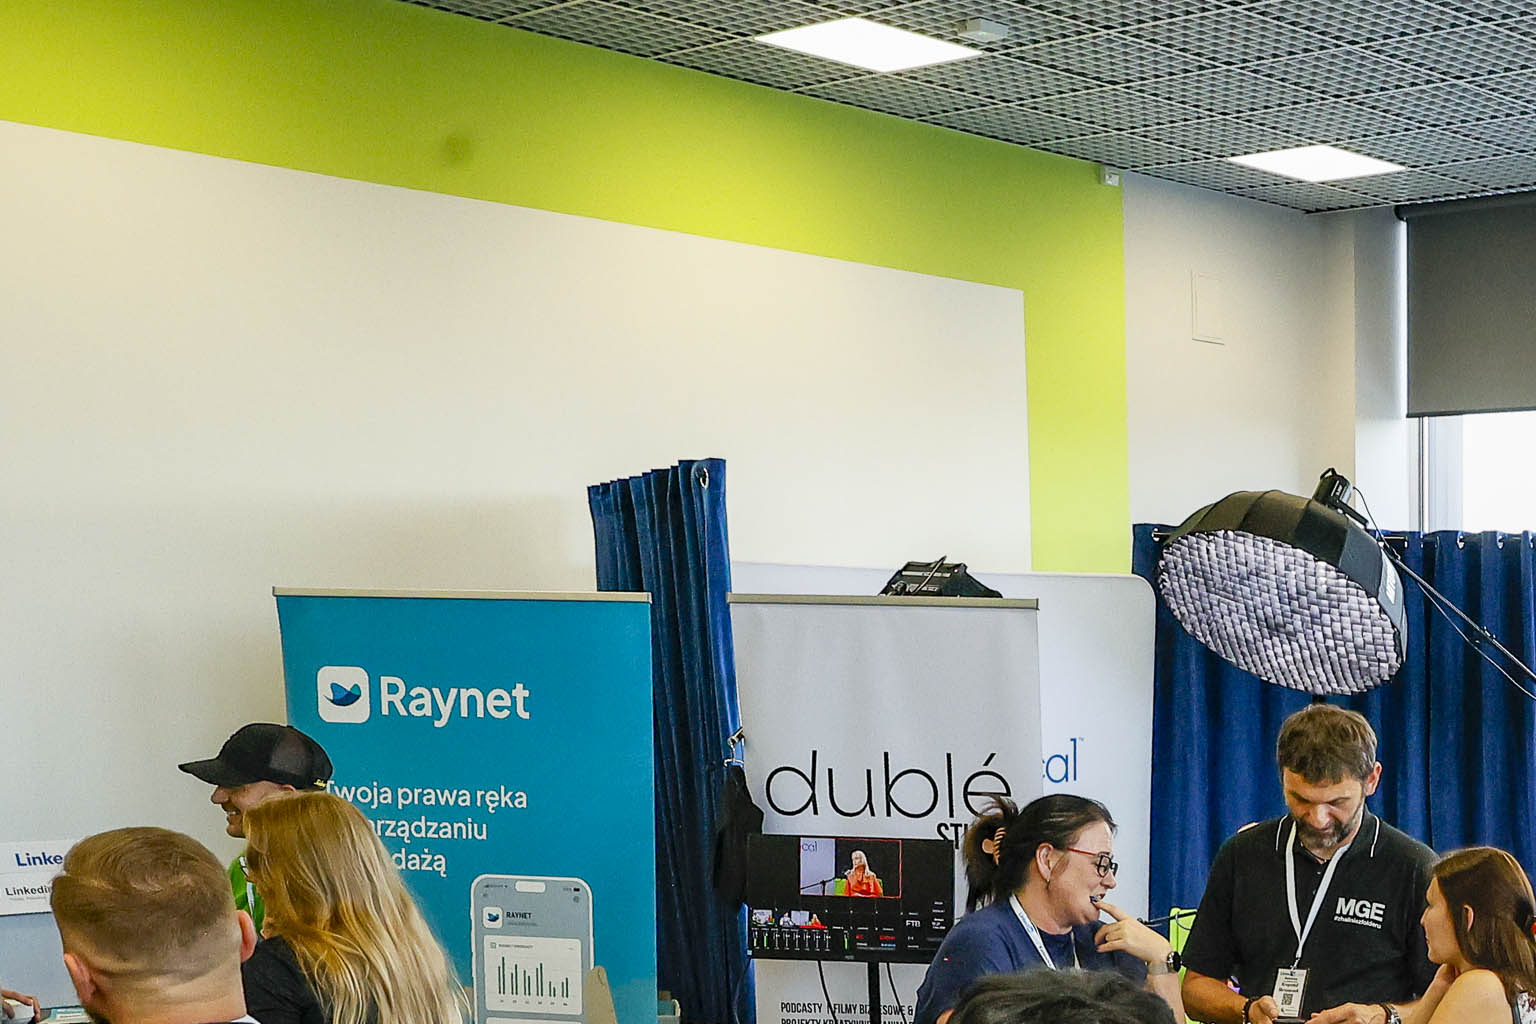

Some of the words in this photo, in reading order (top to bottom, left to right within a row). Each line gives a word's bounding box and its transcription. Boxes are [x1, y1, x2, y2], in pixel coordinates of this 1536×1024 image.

[379, 675, 531, 728] Raynet
[1042, 737, 1077, 784] al
[326, 780, 392, 809] Twoja
[397, 786, 471, 810] prawa
[476, 785, 528, 813] ręka
[765, 749, 1012, 819] dublé
[506, 911, 532, 919] RAYNET
[1335, 897, 1386, 922] MGE
[780, 1002, 823, 1014] PODCASTY
[833, 1003, 857, 1015] FILMY
[908, 1006, 914, 1016] &
